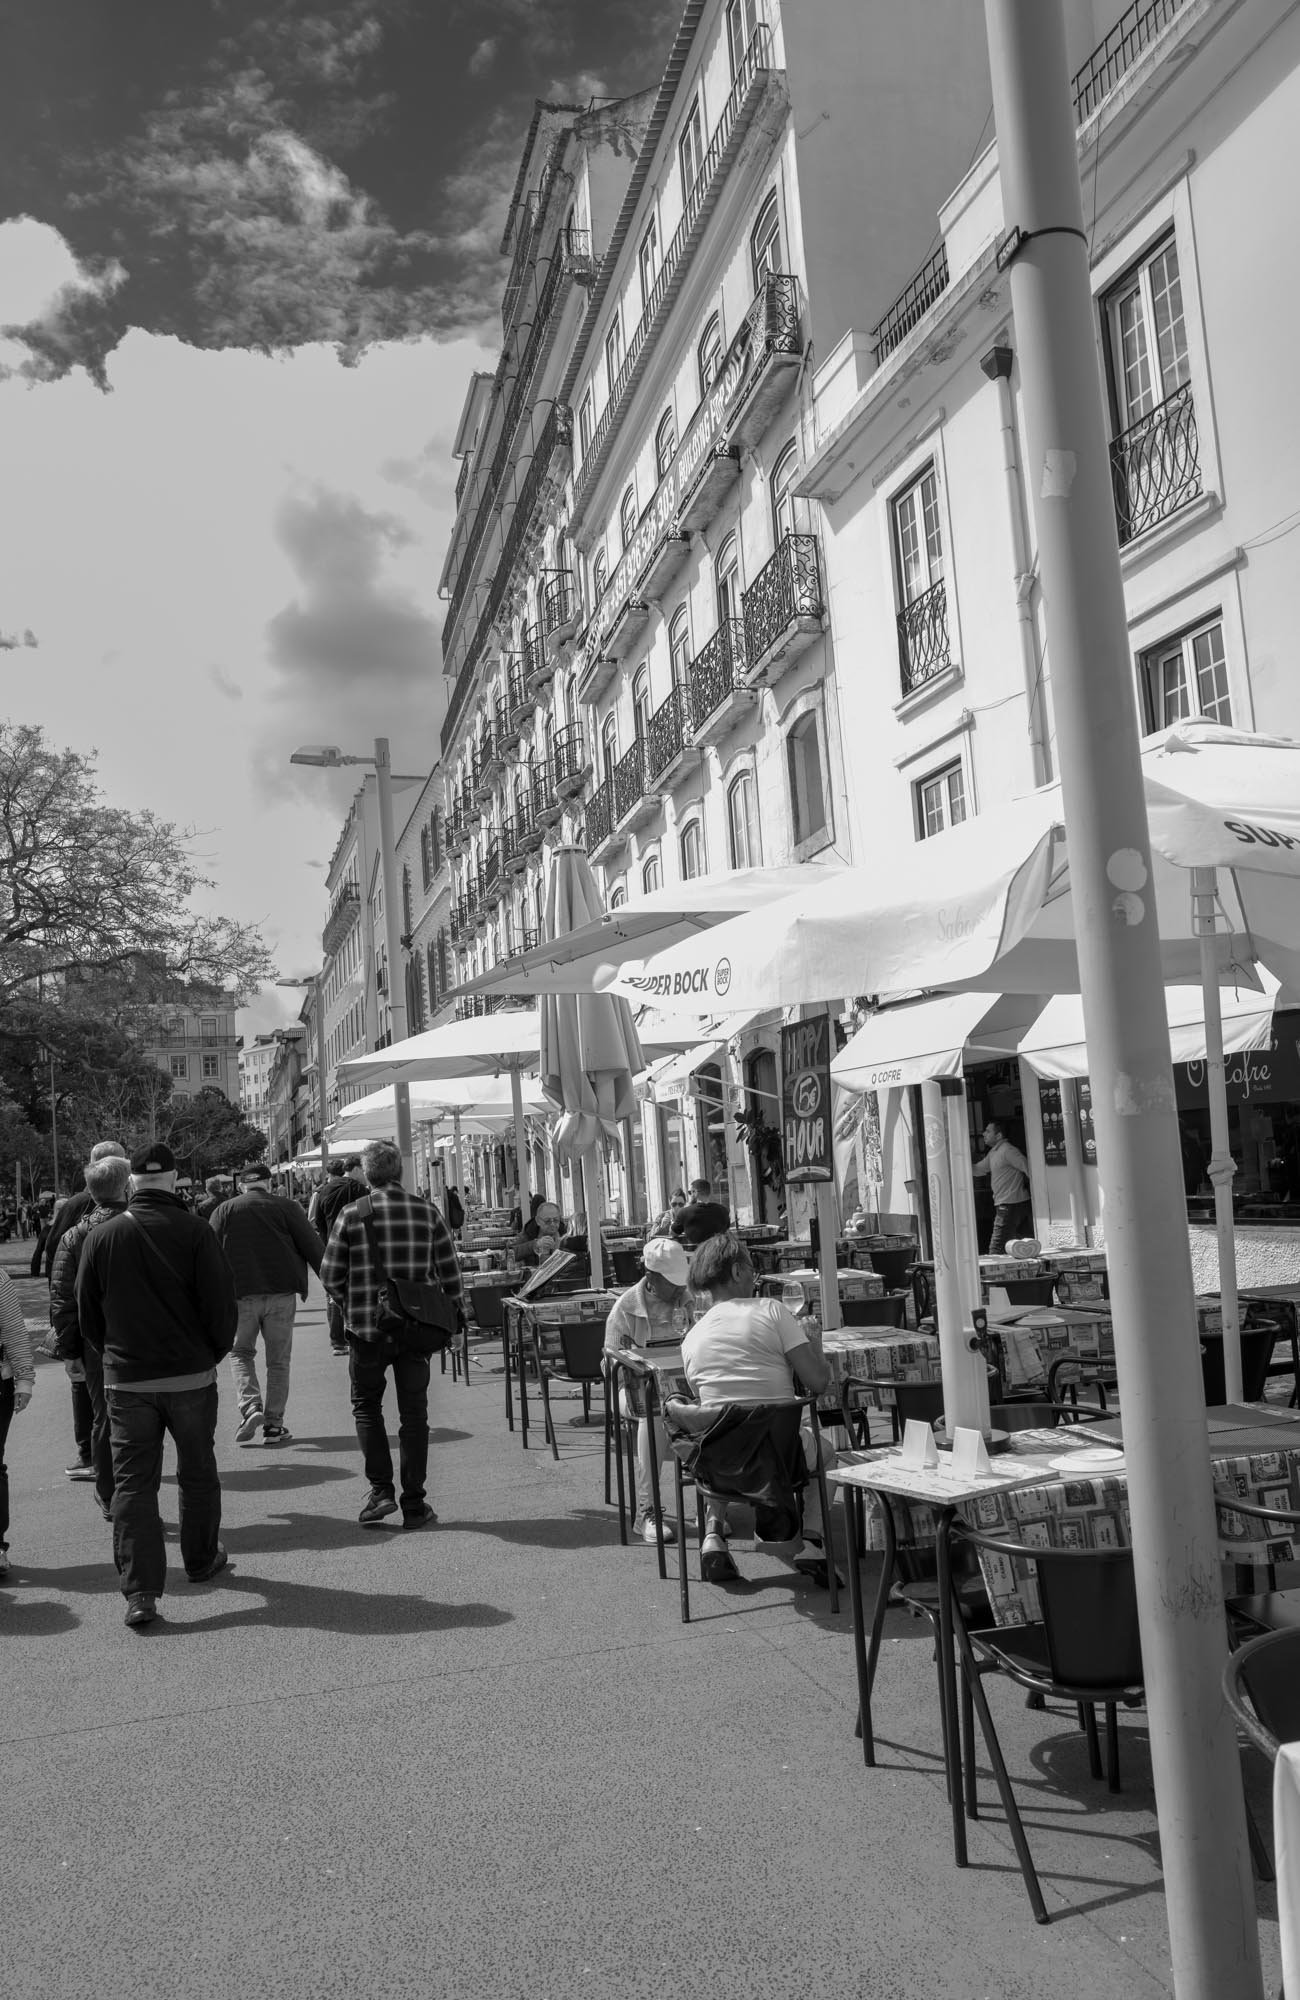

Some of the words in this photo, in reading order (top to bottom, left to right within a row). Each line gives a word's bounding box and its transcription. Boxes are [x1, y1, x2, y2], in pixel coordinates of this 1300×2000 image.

[678, 410, 711, 491] BUILDING
[710, 383, 726, 433] FOR
[1224, 821, 1300, 850] SUP
[620, 974, 671, 996] SUPER
[673, 968, 709, 995] BOCK
[717, 967, 729, 977] SUPER
[717, 976, 728, 986] BOCK
[785, 1019, 825, 1076] HAPPY
[871, 1073, 877, 1085] O
[878, 1069, 902, 1083] COFRE
[786, 1117, 825, 1170] HOUR
